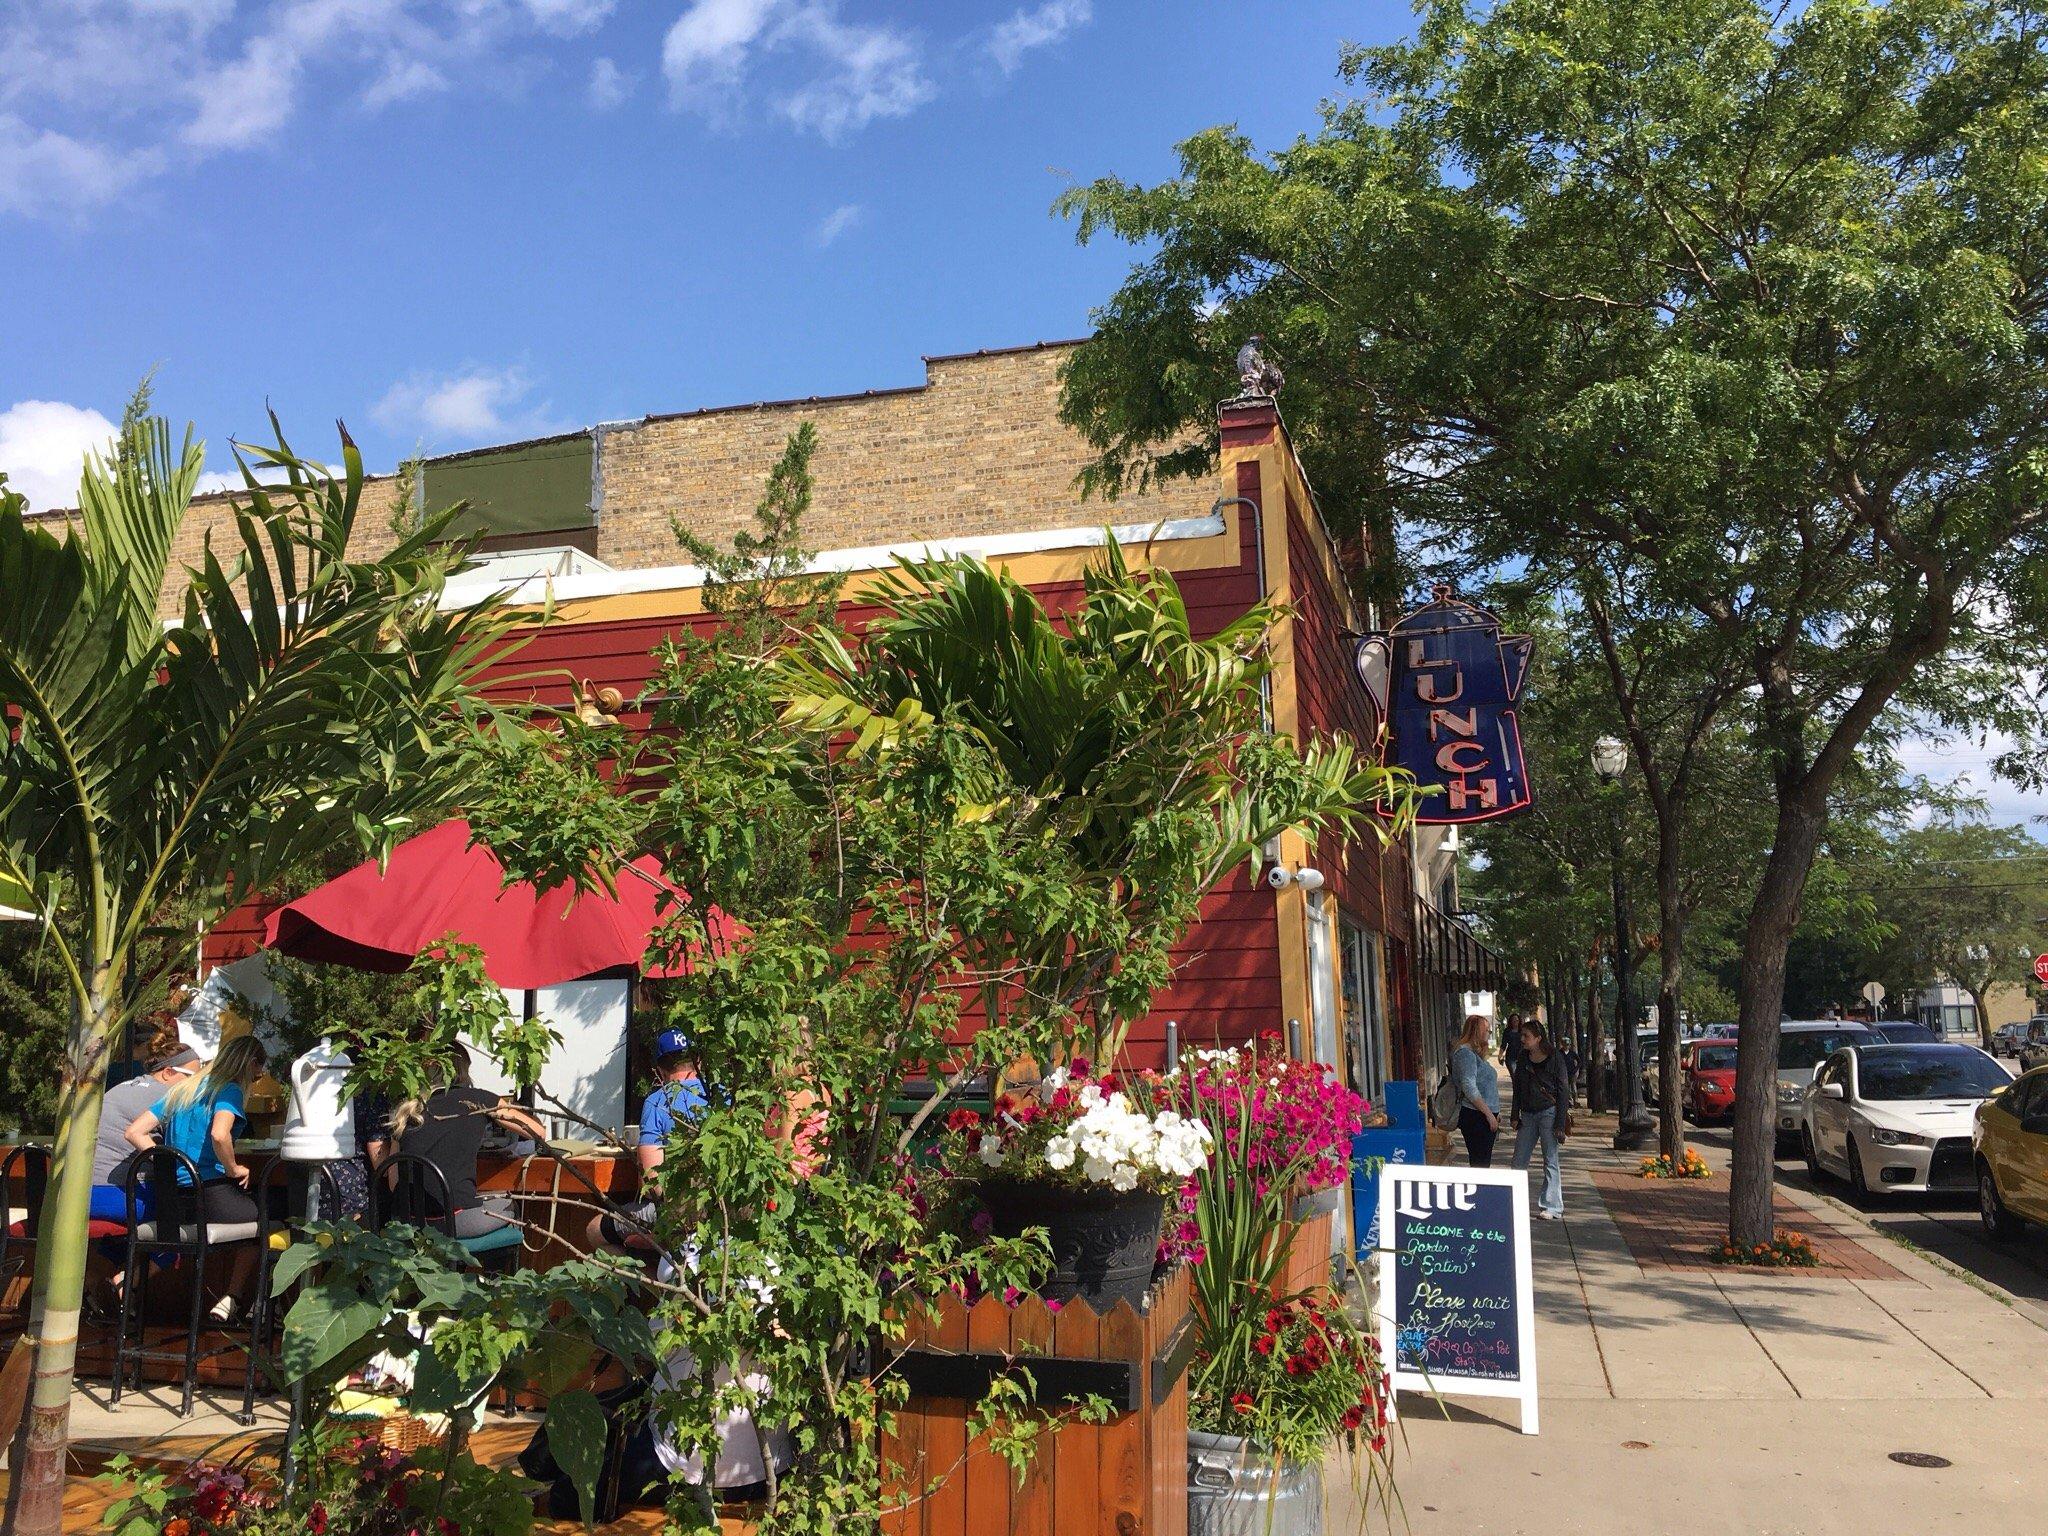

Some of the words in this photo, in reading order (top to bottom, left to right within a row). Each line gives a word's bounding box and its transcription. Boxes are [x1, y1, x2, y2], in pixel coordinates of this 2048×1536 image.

[1408, 639, 1498, 810] LUNCH
[2037, 962, 2048, 973] ST
[673, 1033, 687, 1047] KC
[1406, 1222, 1464, 1238] WELCOME
[1470, 1229, 1483, 1239] to
[1486, 1230, 1506, 1242] the
[1402, 1238, 1450, 1266] Garden
[1408, 1283, 1465, 1309] Please
[1472, 1297, 1510, 1310] wait
[1408, 1309, 1430, 1328] for
